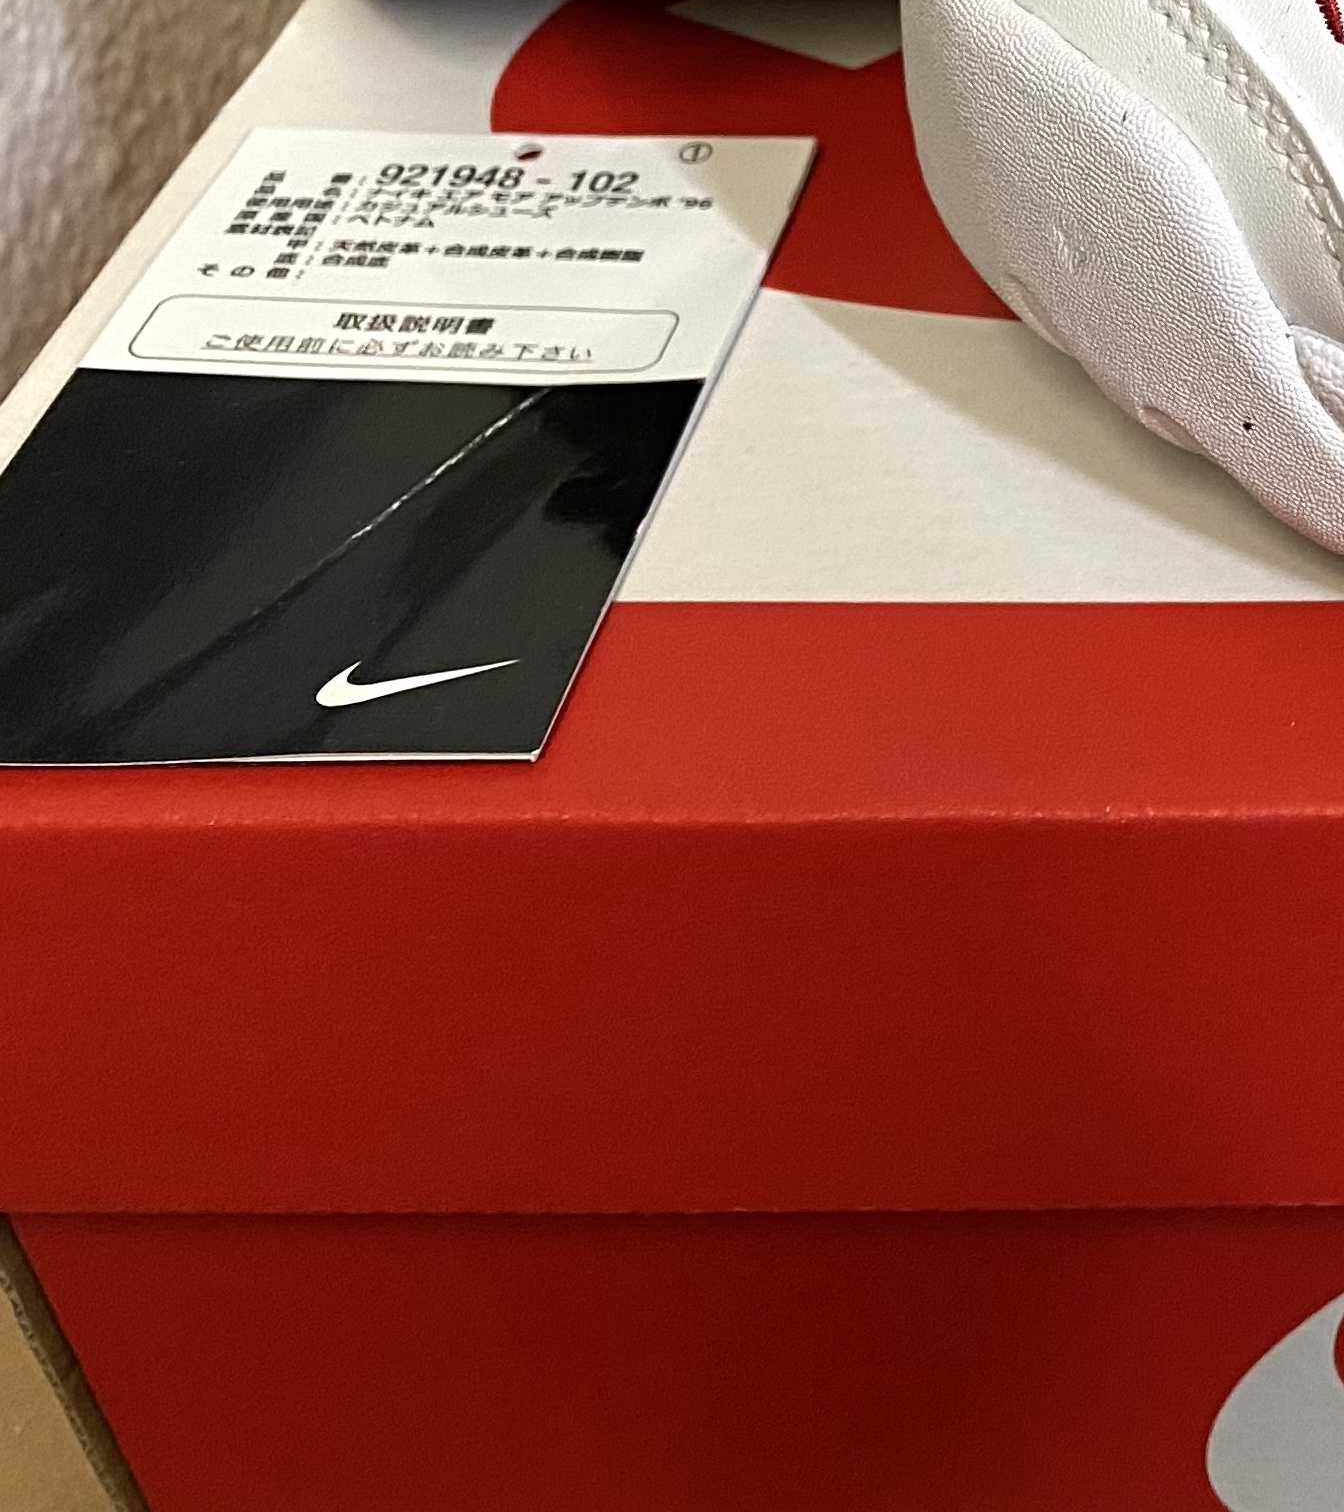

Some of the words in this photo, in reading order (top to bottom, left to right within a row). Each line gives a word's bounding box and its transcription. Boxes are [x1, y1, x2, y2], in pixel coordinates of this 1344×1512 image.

[375, 163, 525, 188] 921948
[570, 170, 640, 193] 102
[333, 312, 495, 335] 取扱説明書
[204, 333, 593, 361] ご使用前に必ずお読み下さい
